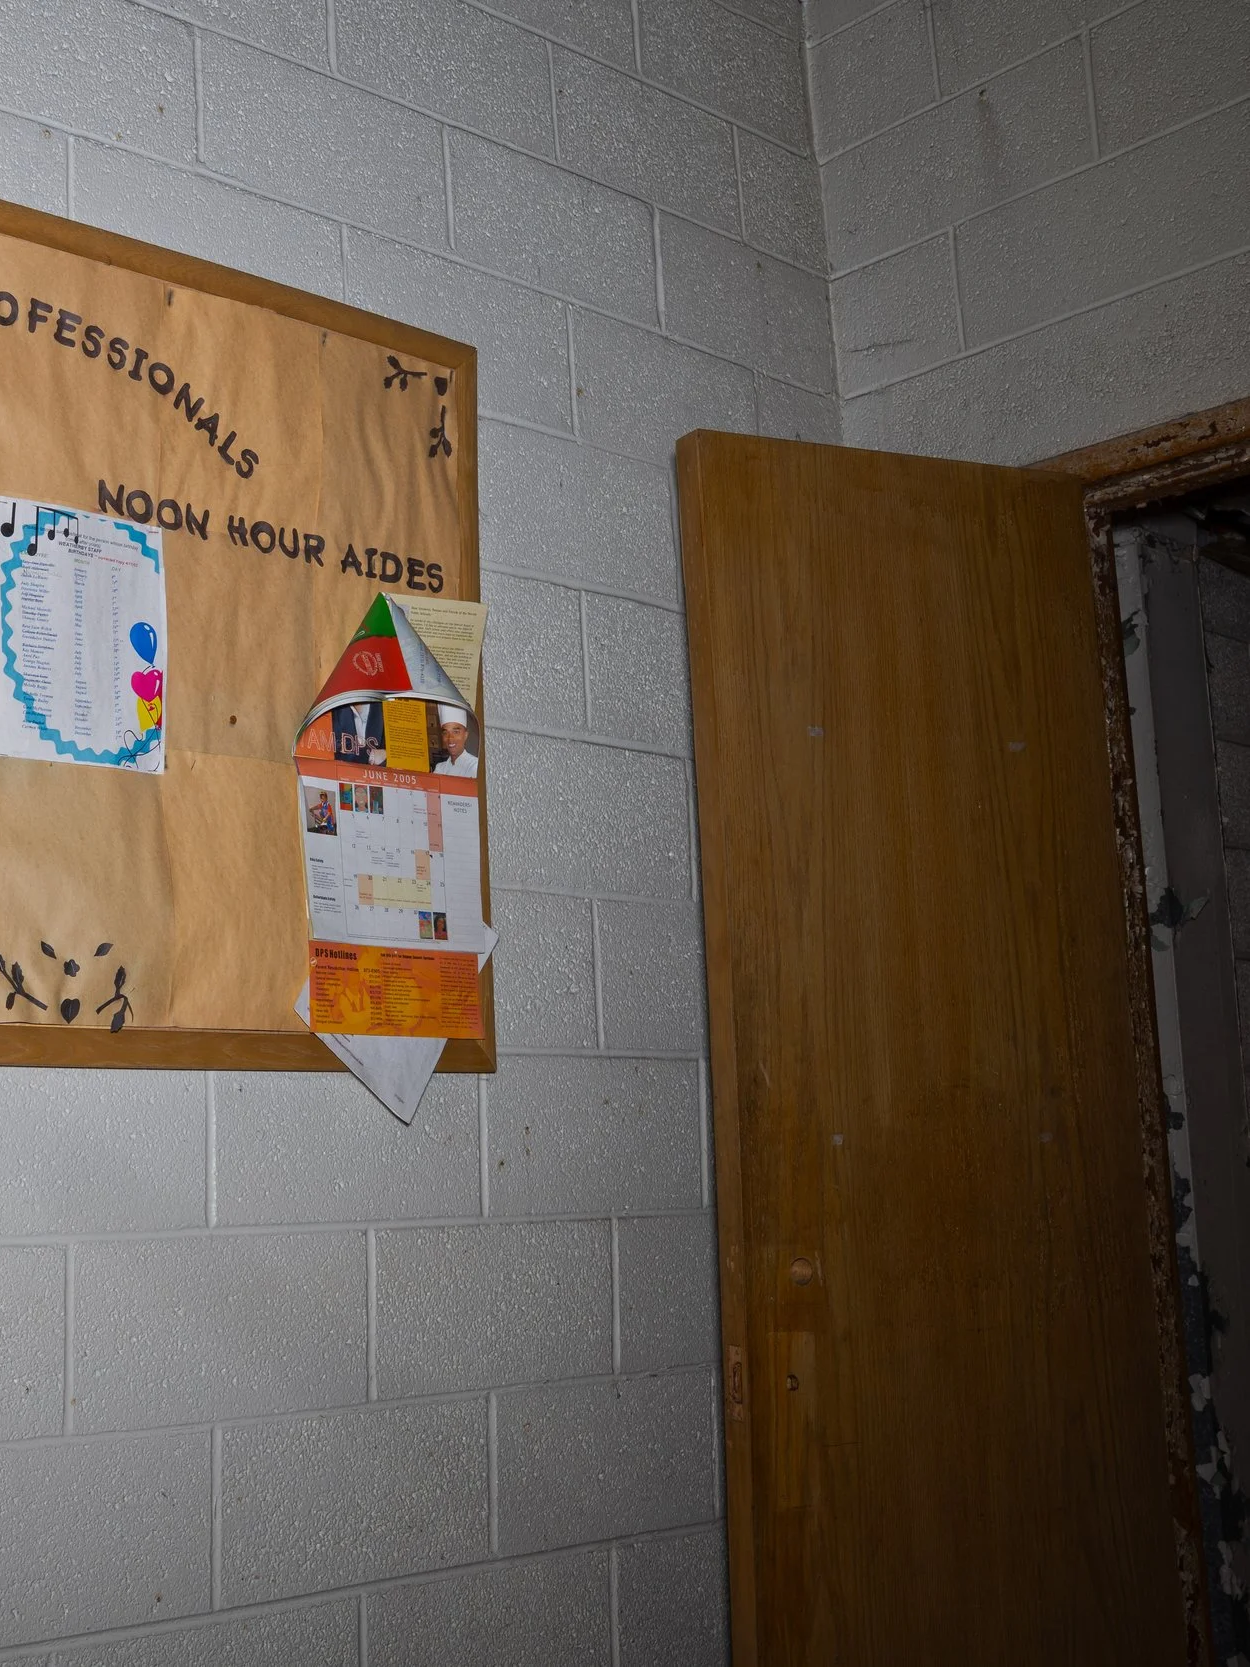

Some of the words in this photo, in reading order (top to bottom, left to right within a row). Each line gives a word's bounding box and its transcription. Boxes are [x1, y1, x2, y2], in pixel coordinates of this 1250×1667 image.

[98, 479, 210, 541] NOON
[227, 515, 326, 568] HOUR
[340, 544, 444, 594] AIDES
[68, 548, 93, 558] BIRTHDAYS
[363, 769, 388, 781] JUNE
[393, 773, 417, 785] 2005
[315, 948, 329, 958] DPS
[329, 949, 358, 960] Hotlines
